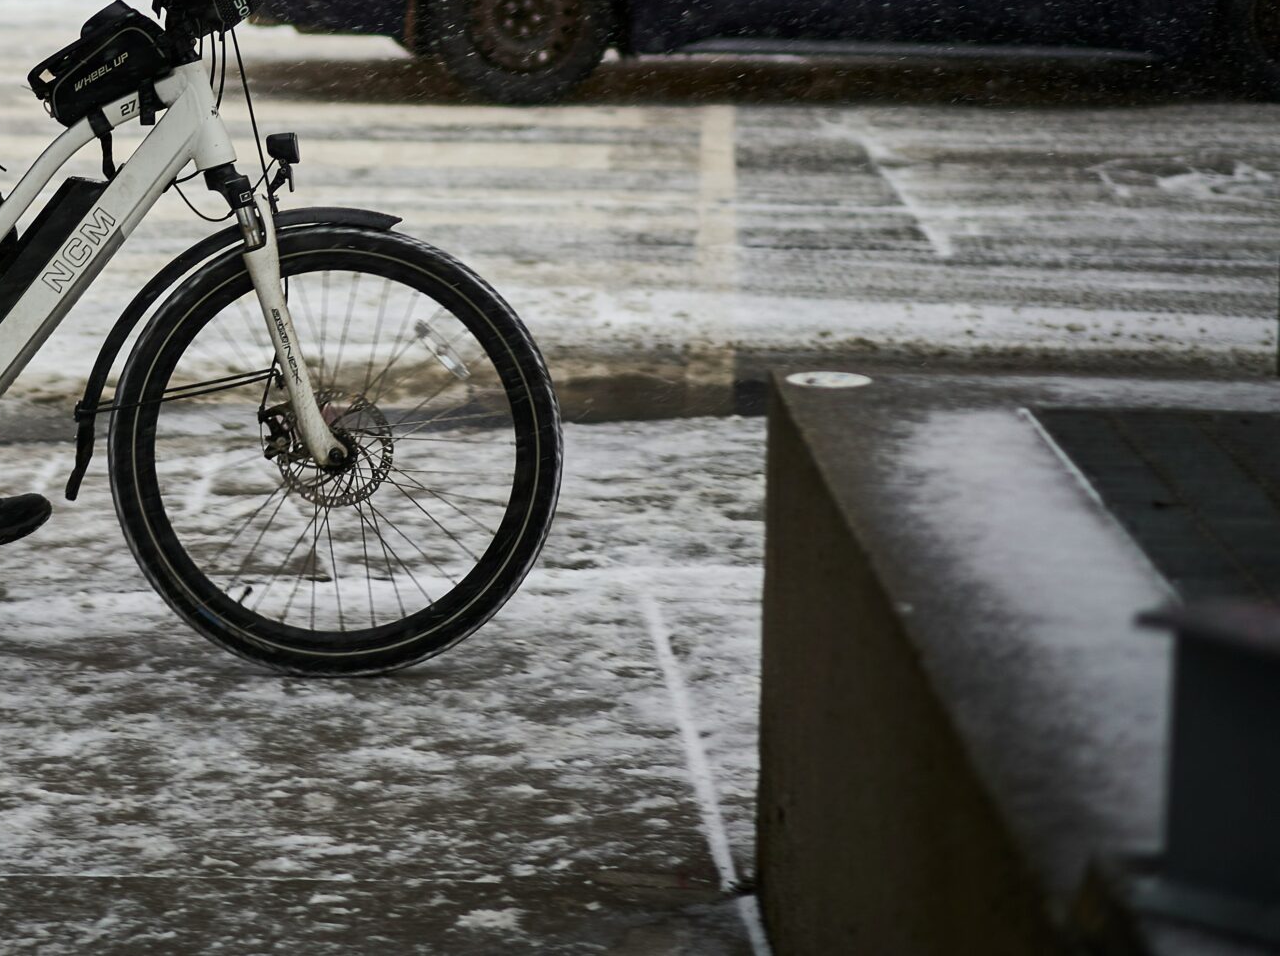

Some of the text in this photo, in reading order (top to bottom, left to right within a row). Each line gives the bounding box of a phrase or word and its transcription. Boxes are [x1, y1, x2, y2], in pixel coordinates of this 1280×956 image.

[74, 52, 129, 92] WHEEL UP
[41, 206, 116, 294] NCM
